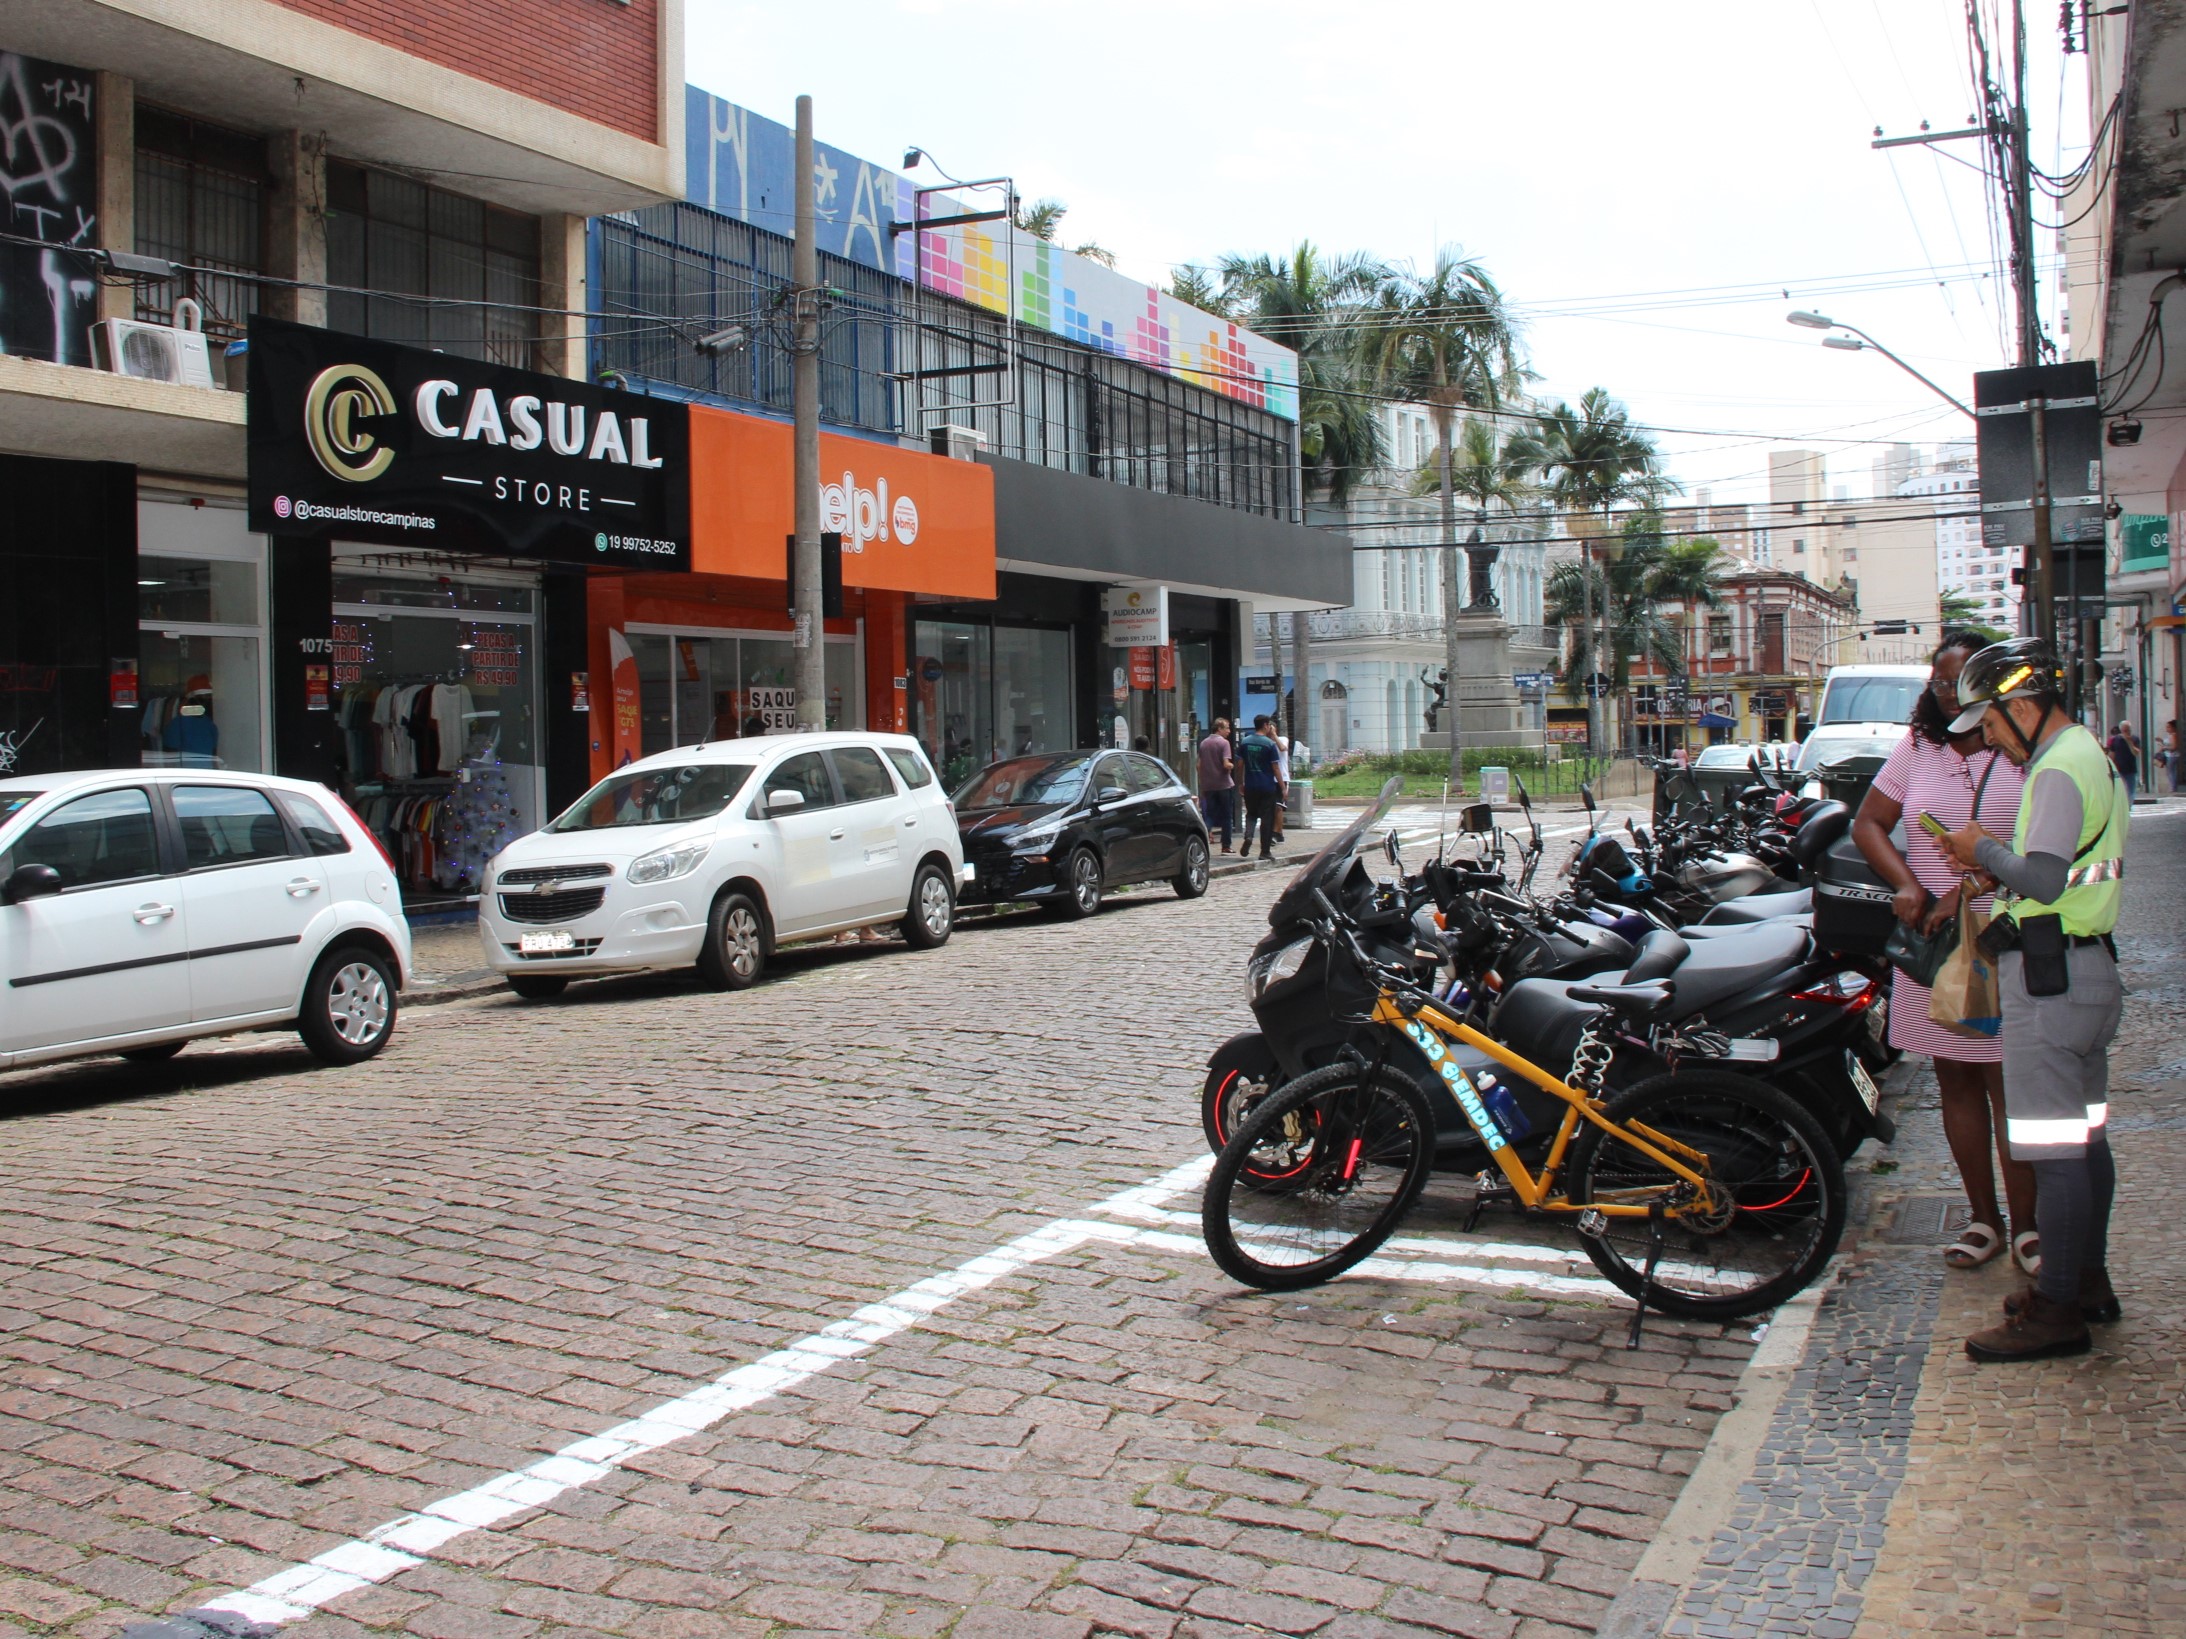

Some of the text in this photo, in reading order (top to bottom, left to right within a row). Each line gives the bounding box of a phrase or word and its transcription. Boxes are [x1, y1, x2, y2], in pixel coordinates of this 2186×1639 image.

[416, 379, 663, 469] CASUAL
[494, 475, 592, 512] STORE
[294, 500, 436, 530] @casualstorecampinas
[818, 470, 889, 554] elp!
[608, 534, 677, 556] 19 99752-5252
[1112, 607, 1158, 617] AUDIOCAMP
[300, 638, 333, 653] 1075
[349, 645, 364, 663] DE
[472, 650, 520, 668] PARTIR DE
[751, 691, 795, 709] SAQU
[1657, 698, 1702, 713] CHRIA
[763, 712, 795, 729] SEU
[1451, 1077, 1506, 1152] EMDEC
